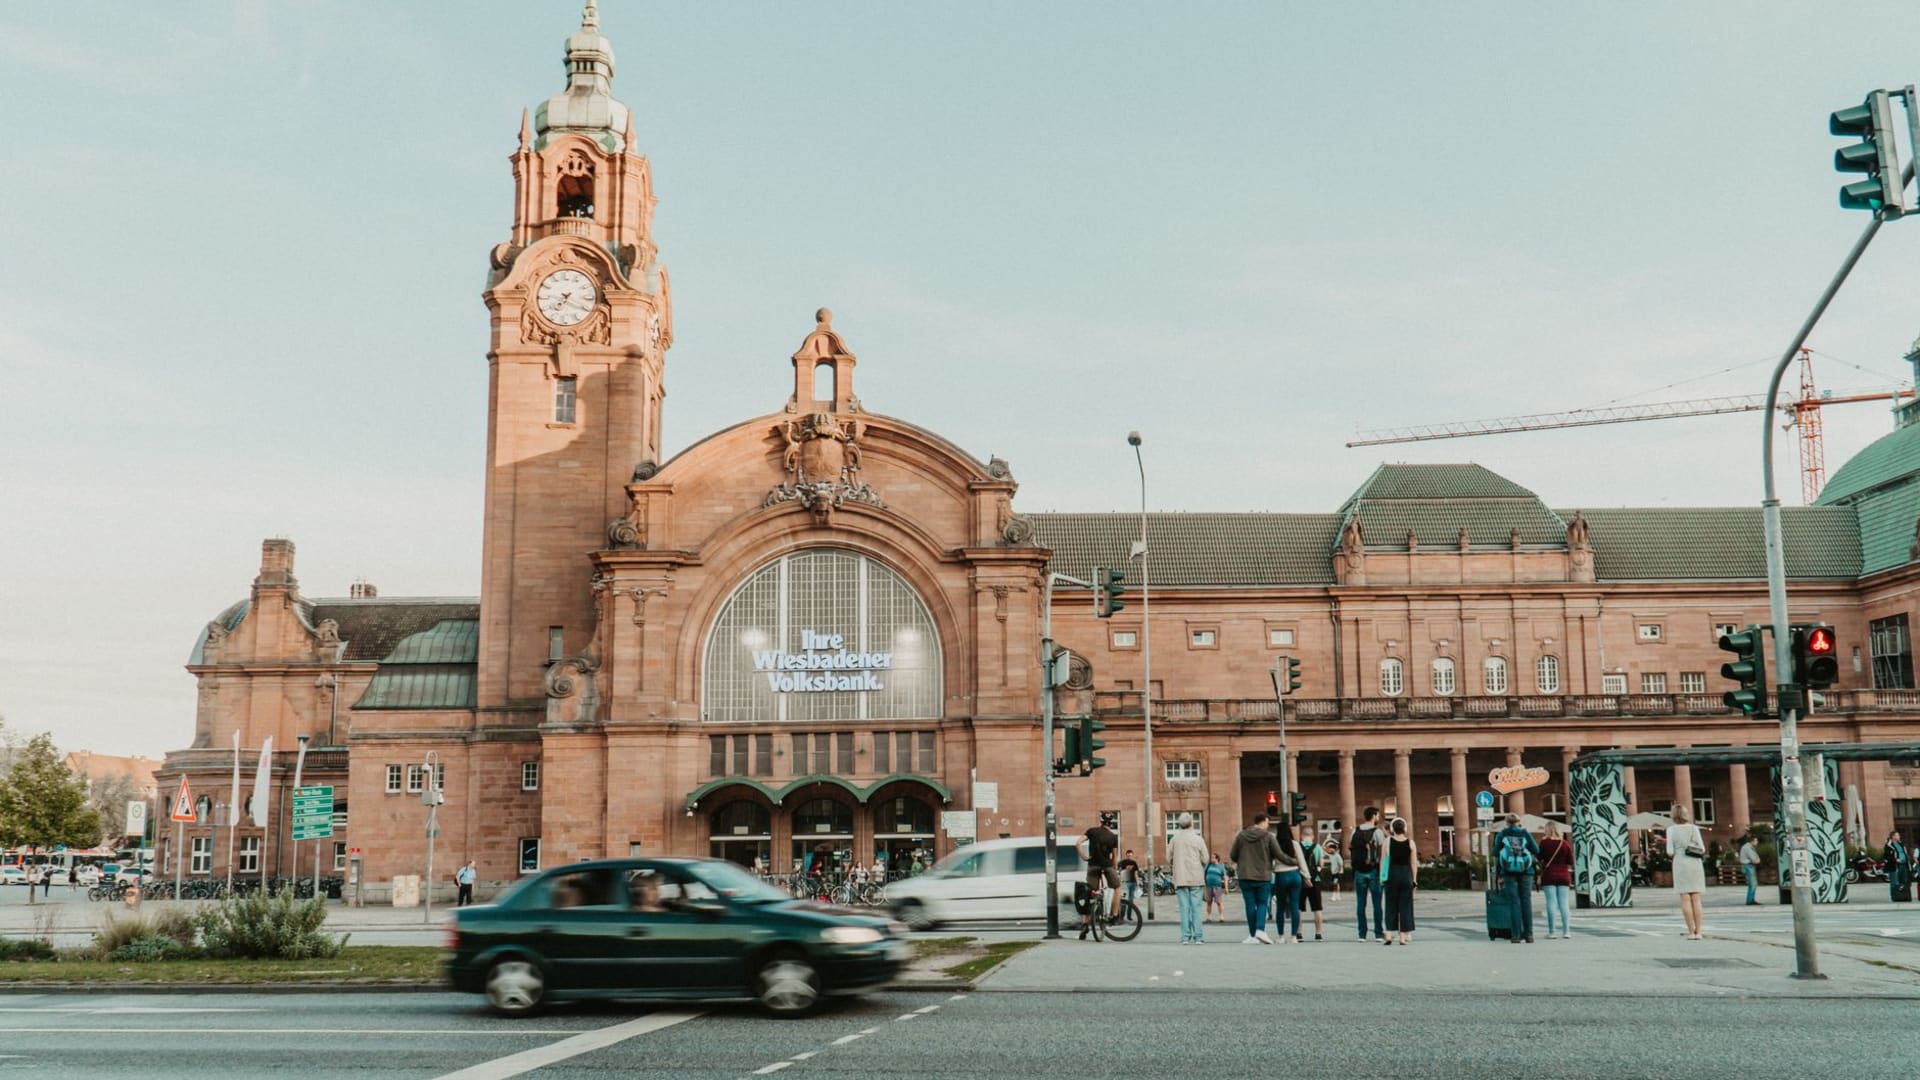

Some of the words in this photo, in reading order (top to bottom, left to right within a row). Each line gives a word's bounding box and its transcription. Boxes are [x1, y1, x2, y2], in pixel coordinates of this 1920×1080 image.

[801, 629, 844, 650] Ihre
[753, 648, 893, 669] Wiesbadener
[768, 671, 884, 692] Volksbank.
